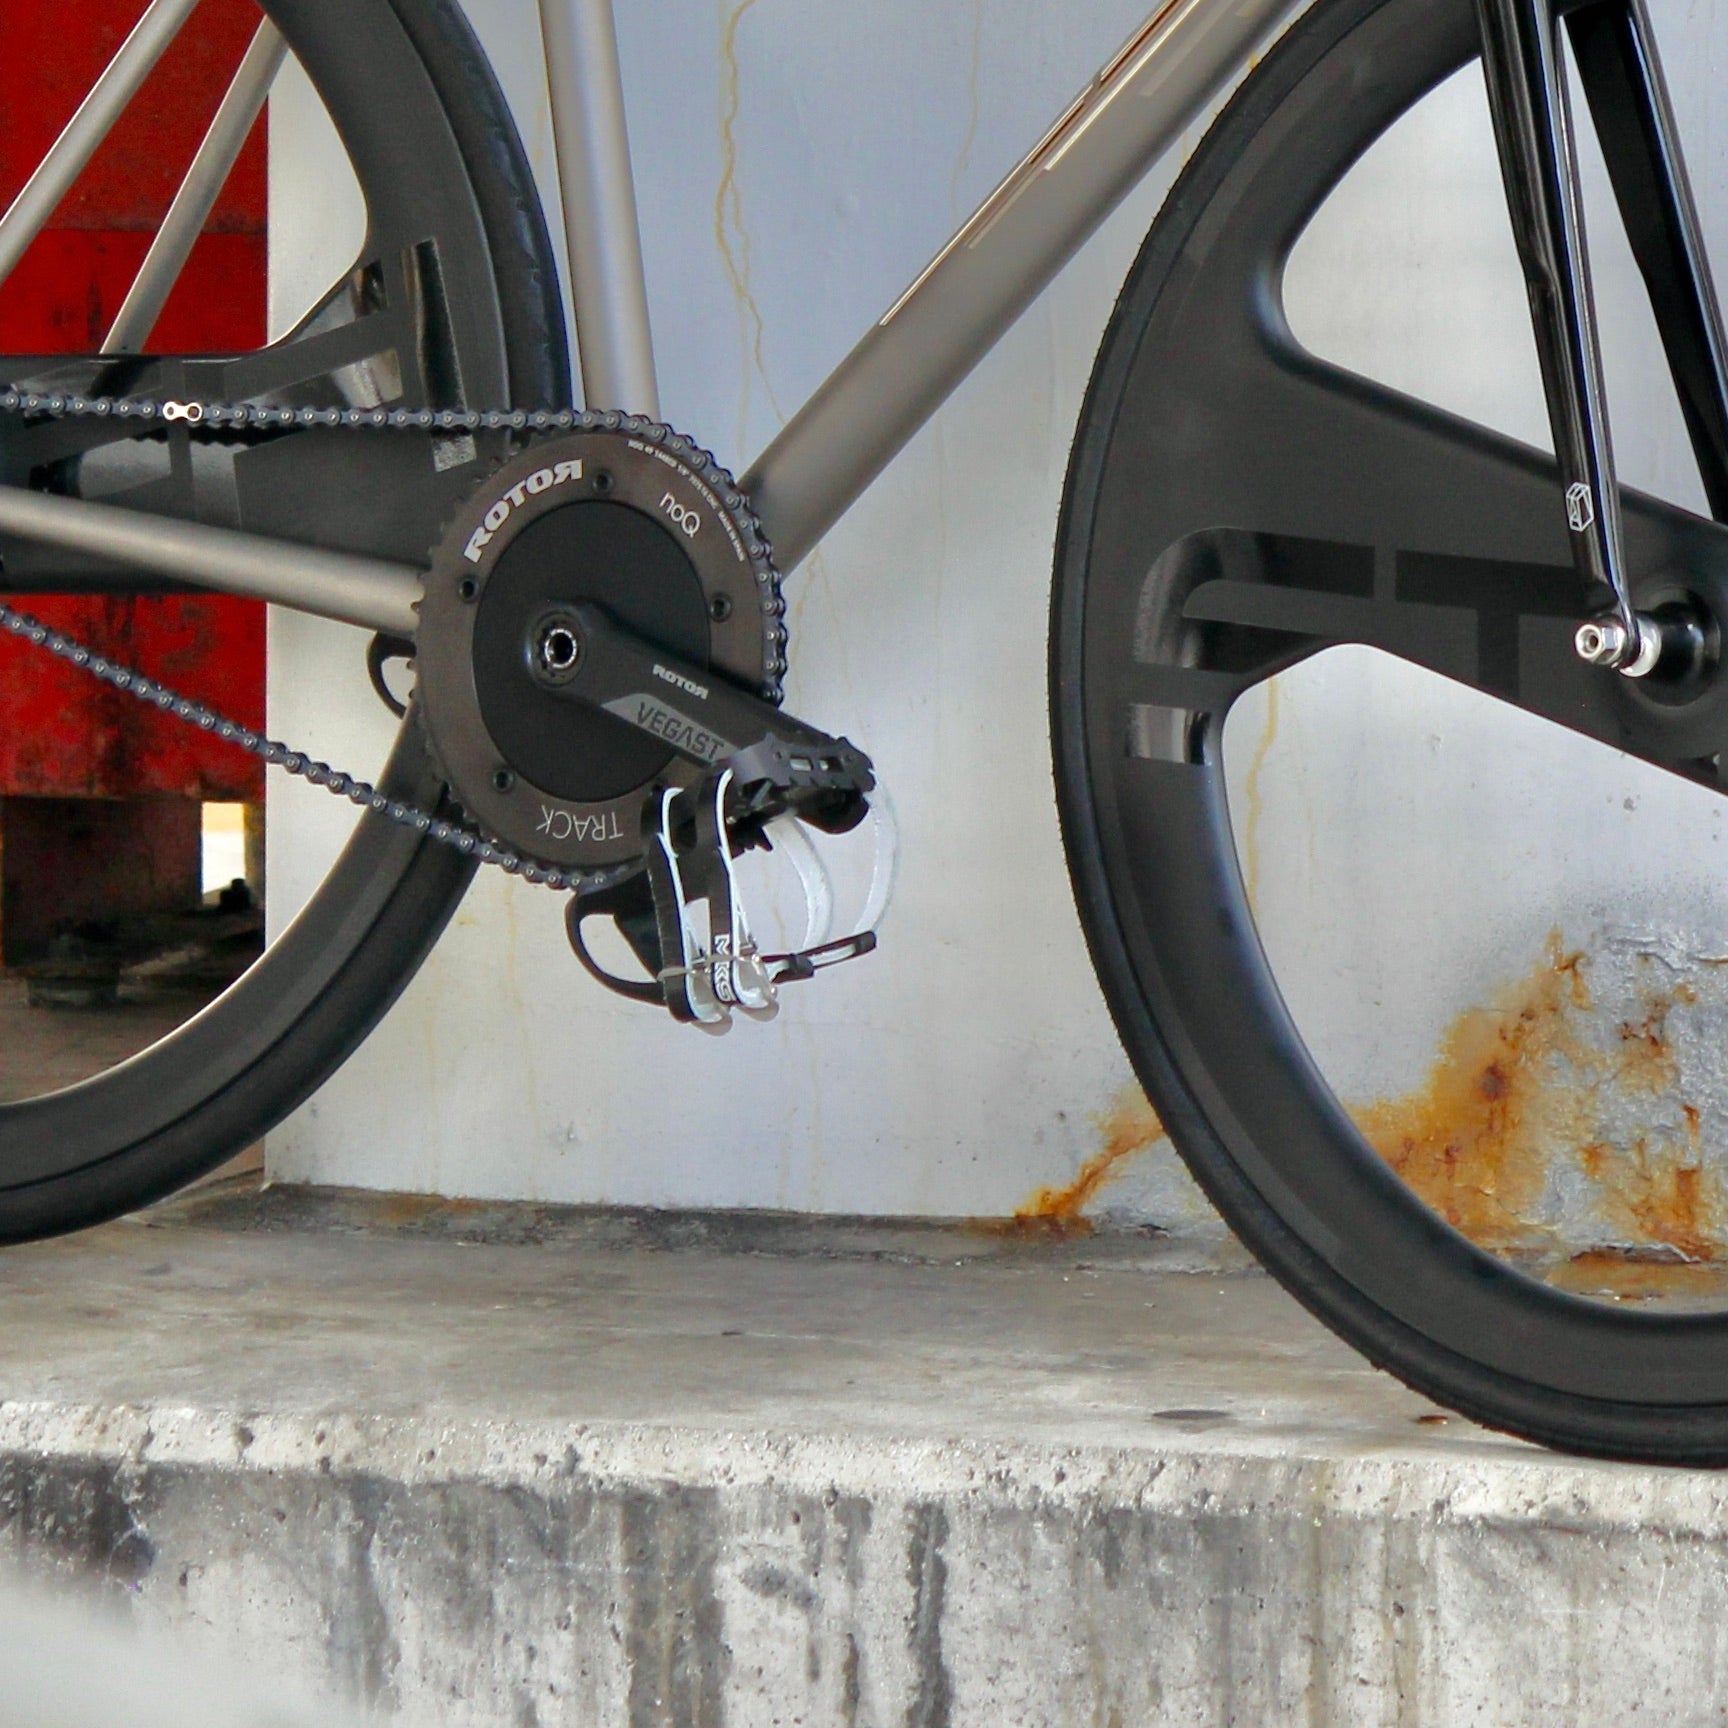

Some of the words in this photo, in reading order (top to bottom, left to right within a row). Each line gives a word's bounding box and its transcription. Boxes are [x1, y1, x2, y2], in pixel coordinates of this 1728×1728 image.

[464, 458, 583, 563] ROTOR
[652, 663, 710, 701] ROTOR
[636, 702, 725, 760] VEGAST
[536, 804, 625, 842] TRACK
